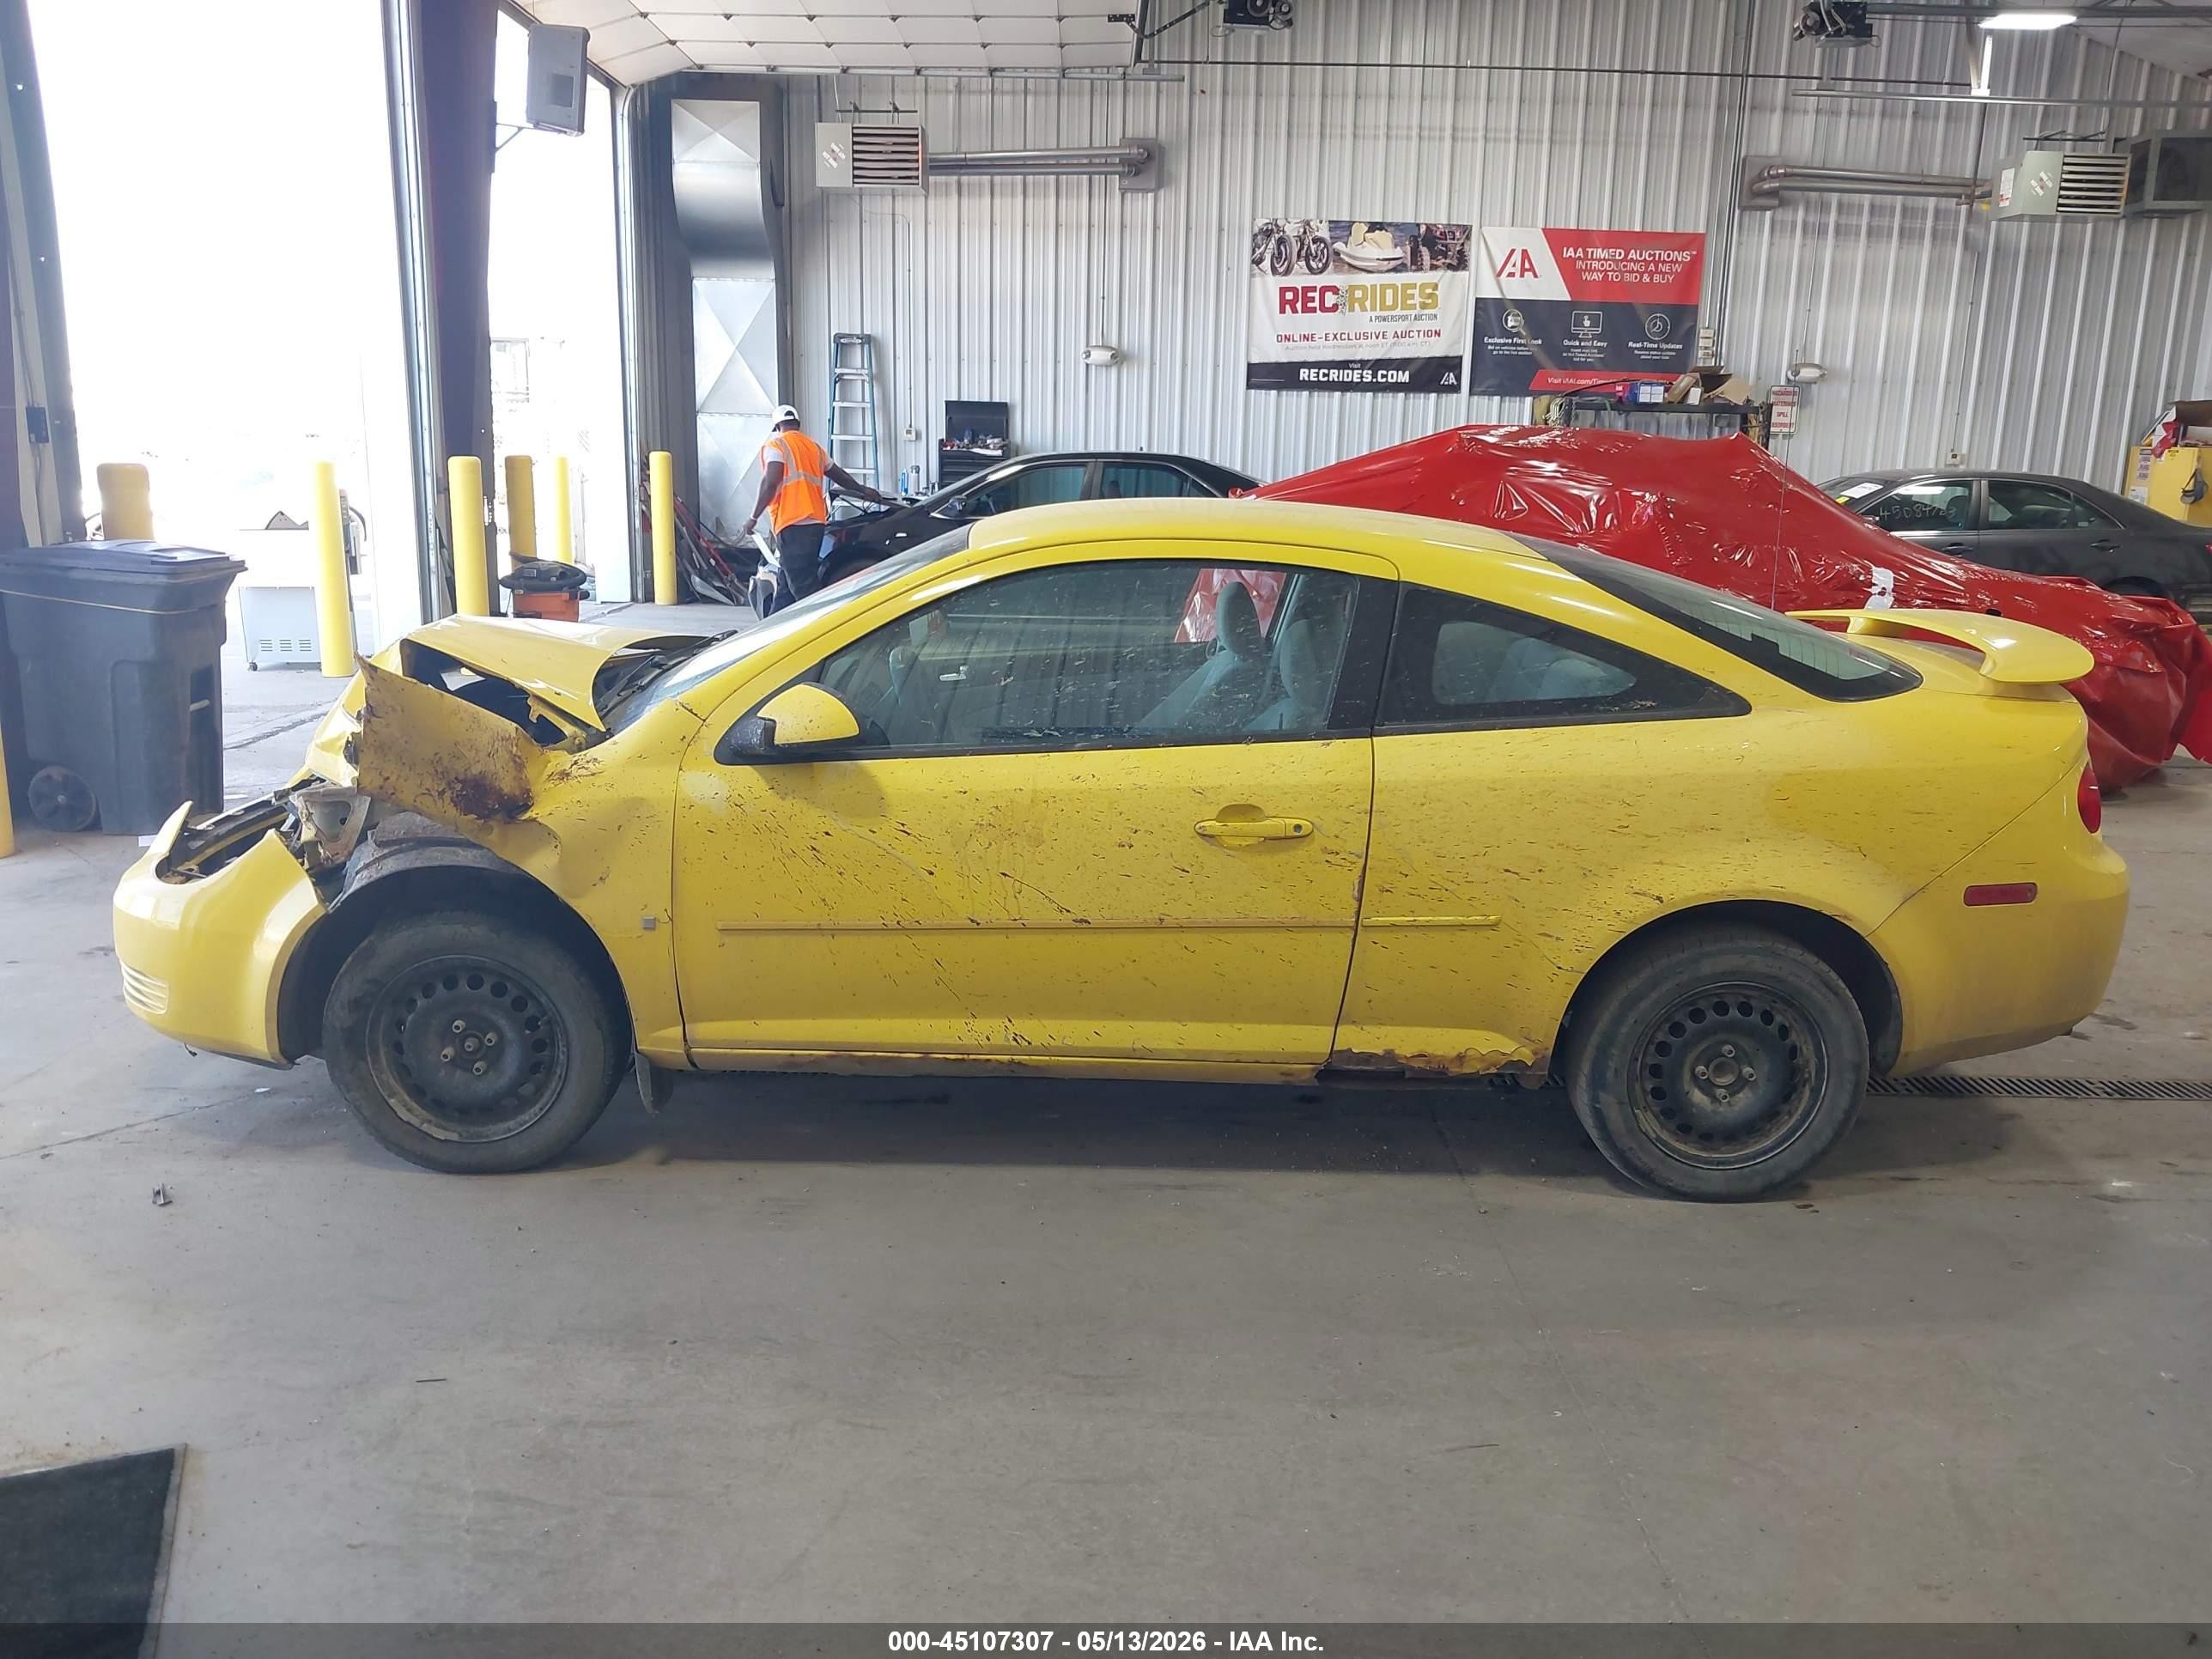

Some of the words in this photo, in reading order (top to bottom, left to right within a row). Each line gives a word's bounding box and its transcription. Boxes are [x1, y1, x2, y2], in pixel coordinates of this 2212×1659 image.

[1563, 247, 1583, 258] IAA
[1586, 248, 1625, 260] TIMED
[1576, 260, 1644, 272] INTRODUCING
[1648, 263, 1656, 272] A
[1658, 263, 1683, 273] NEW
[1581, 271, 1605, 282] WAY
[1607, 272, 1621, 282] TO
[1623, 273, 1639, 283] BID
[1643, 273, 1650, 283] &
[1653, 274, 1675, 283] BUY
[1279, 285, 1340, 315] REC
[1347, 282, 1439, 313] RIDES
[1374, 314, 1413, 324] POWERSPORT
[1413, 313, 1437, 322] AUCTION
[1276, 331, 1389, 343] ONLINE-EXCLUSIVE
[1392, 328, 1442, 340] AUCTION
[1299, 368, 1410, 383] RECRIDES.COM
